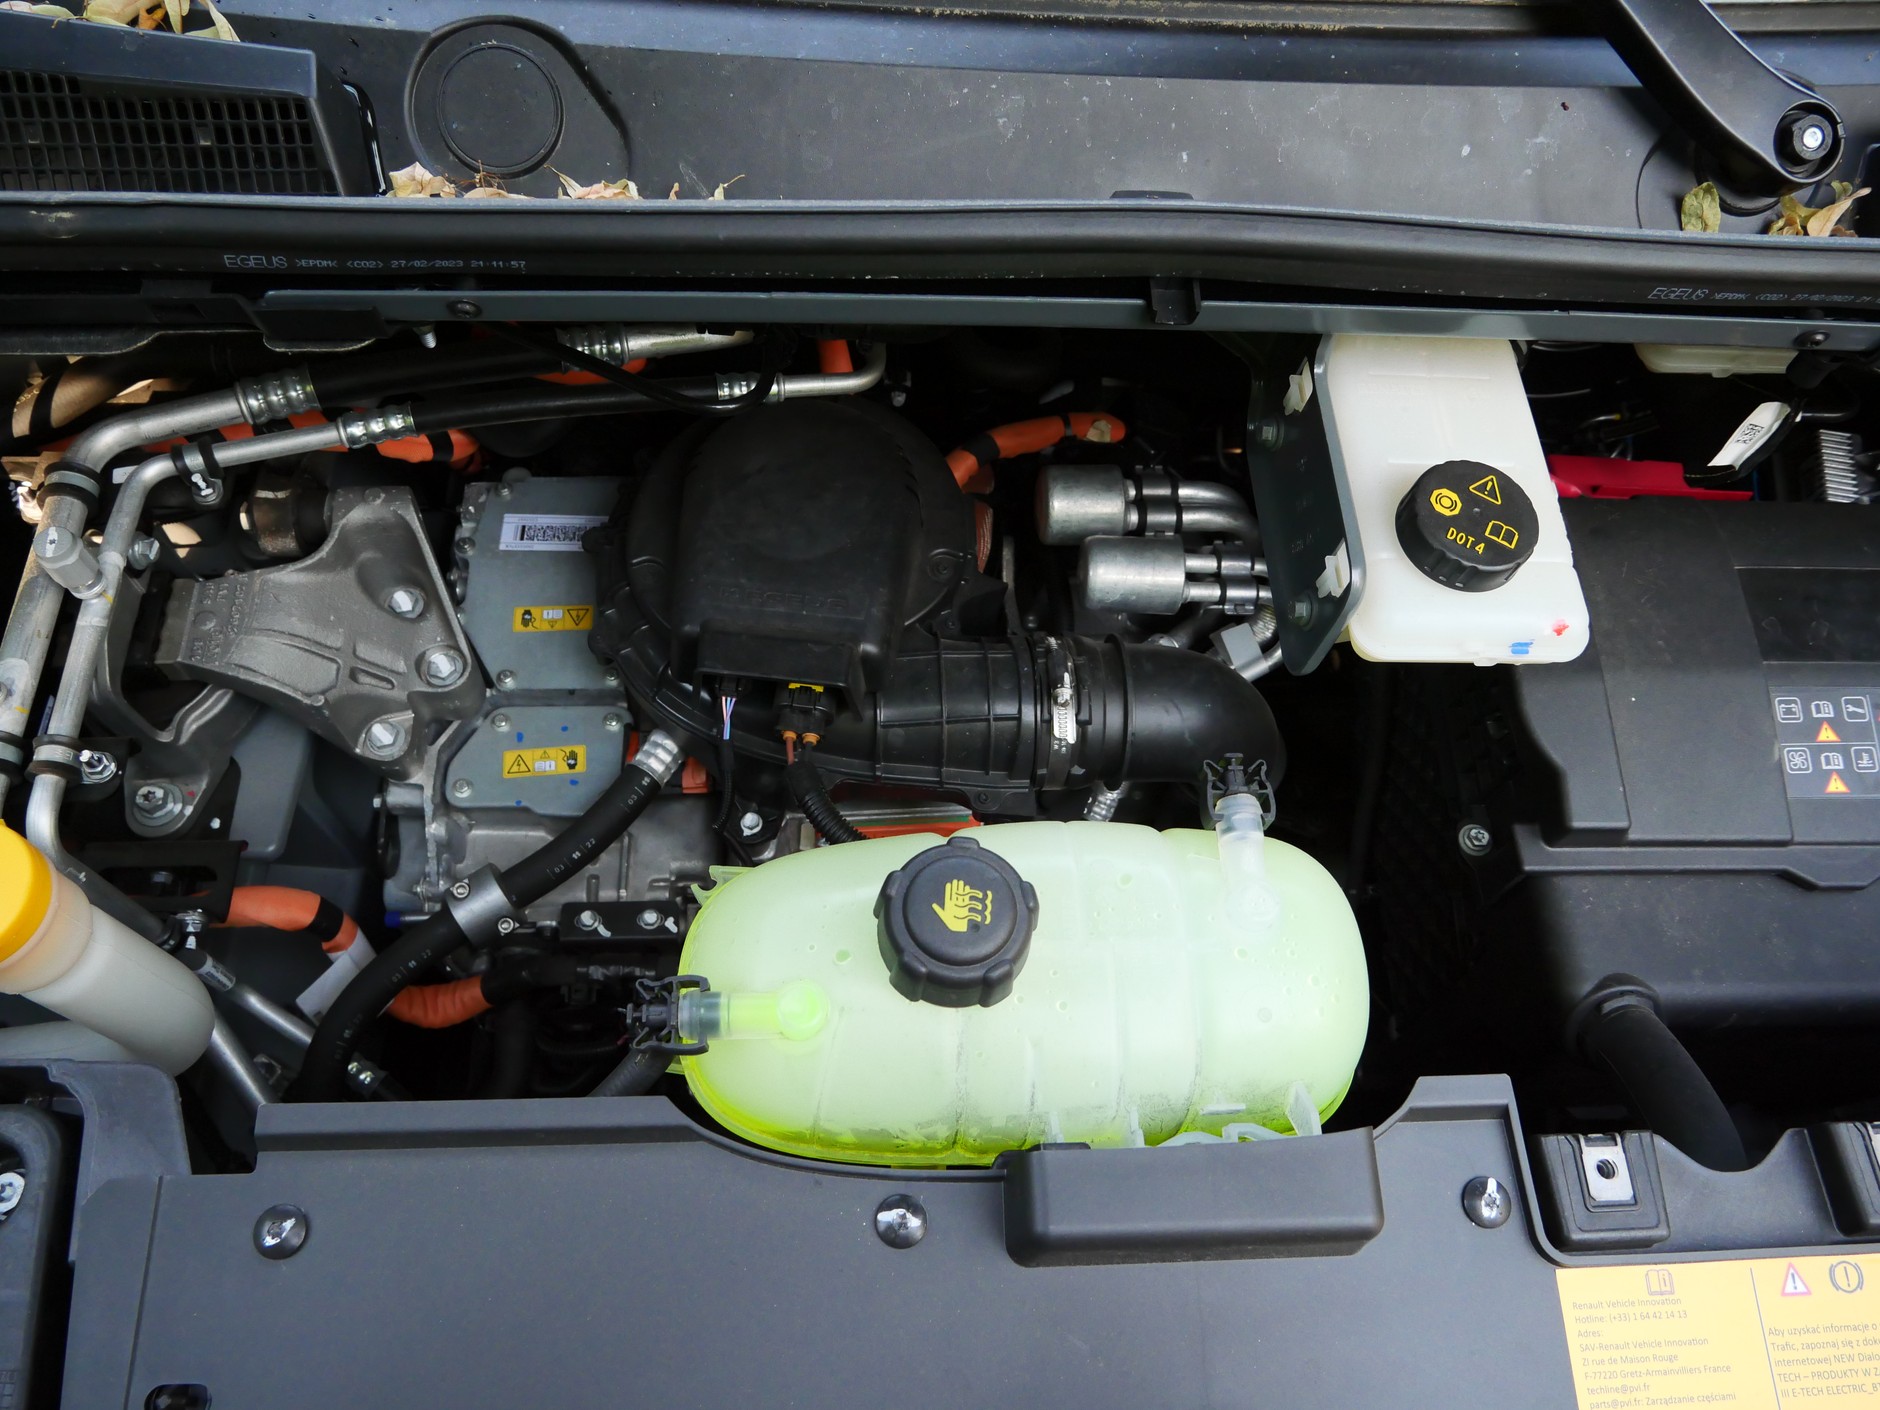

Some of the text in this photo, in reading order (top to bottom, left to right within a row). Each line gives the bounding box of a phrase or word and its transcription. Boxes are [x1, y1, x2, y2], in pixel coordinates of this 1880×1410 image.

[224, 254, 288, 269] EGEUS
[391, 259, 464, 268] 27/02/2023
[1648, 287, 1709, 300] EGEUS
[1572, 1296, 1682, 1311] Renault Vehicle Innovation
[1574, 1313, 1608, 1325] Hotline:
[1609, 1312, 1631, 1324] (+33)
[1639, 1311, 1651, 1321] 64
[1652, 1311, 1663, 1320] 42
[1665, 1310, 1675, 1319] 14
[1677, 1309, 1688, 1319] 13
[1577, 1329, 1604, 1339] Adres:
[1768, 1326, 1785, 1338] Aby
[1787, 1324, 1821, 1337] uzyskać
[1822, 1322, 1870, 1335] informacje
[1579, 1337, 1709, 1353] SAV-Renault Vehicle Innovation
[1771, 1341, 1799, 1353] Trafic,
[1801, 1339, 1840, 1352] zapoznaj
[1841, 1338, 1854, 1350] się
[1591, 1358, 1606, 1366] rue
[1607, 1355, 1618, 1365] de
[1620, 1354, 1651, 1365] Maison
[1652, 1352, 1679, 1364] Rouge
[1774, 1354, 1832, 1368] internetowej
[1833, 1353, 1855, 1364] NEW
[1584, 1364, 1732, 1381] F-77220 Gretz-Armainvilliers France
[1777, 1372, 1801, 1383] TECH
[1811, 1368, 1859, 1381] PRODUKTY
[1861, 1367, 1872, 1377] W
[1872, 1366, 1880, 1376] Z
[1587, 1382, 1651, 1396] techline@pvi.fr
[1791, 1386, 1824, 1398] E-TECH
[1589, 1391, 1738, 1410] parts@pvi.fr: Zarządzanie częściami
